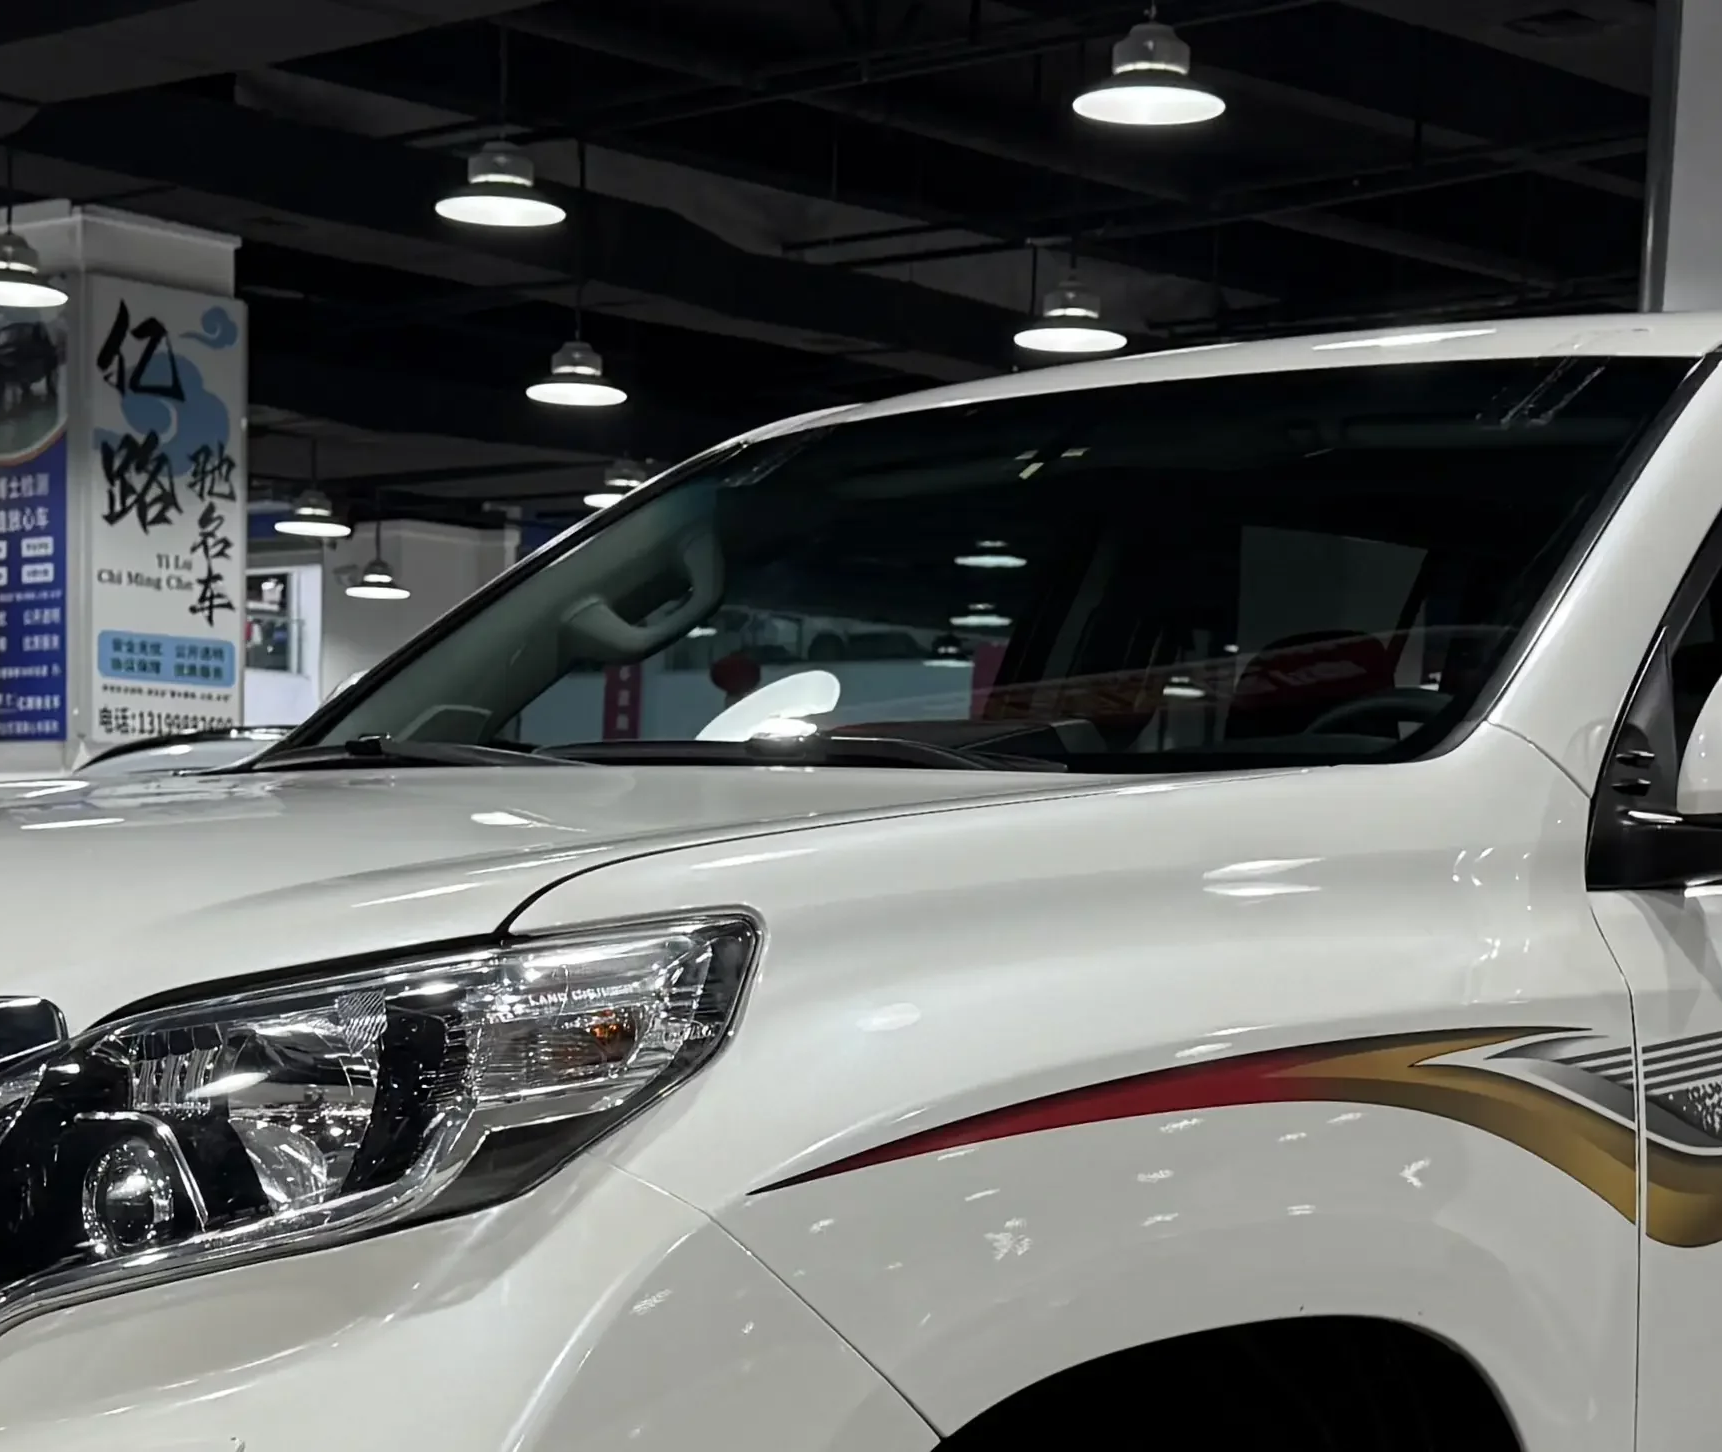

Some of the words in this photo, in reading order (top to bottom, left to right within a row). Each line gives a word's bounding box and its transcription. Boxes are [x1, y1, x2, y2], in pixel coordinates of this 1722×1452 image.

[96, 298, 186, 535] 亿路
[97, 568, 122, 585] Chi
[127, 570, 162, 591] Ming
[166, 574, 193, 591] Che
[186, 443, 237, 627] 驰名车
